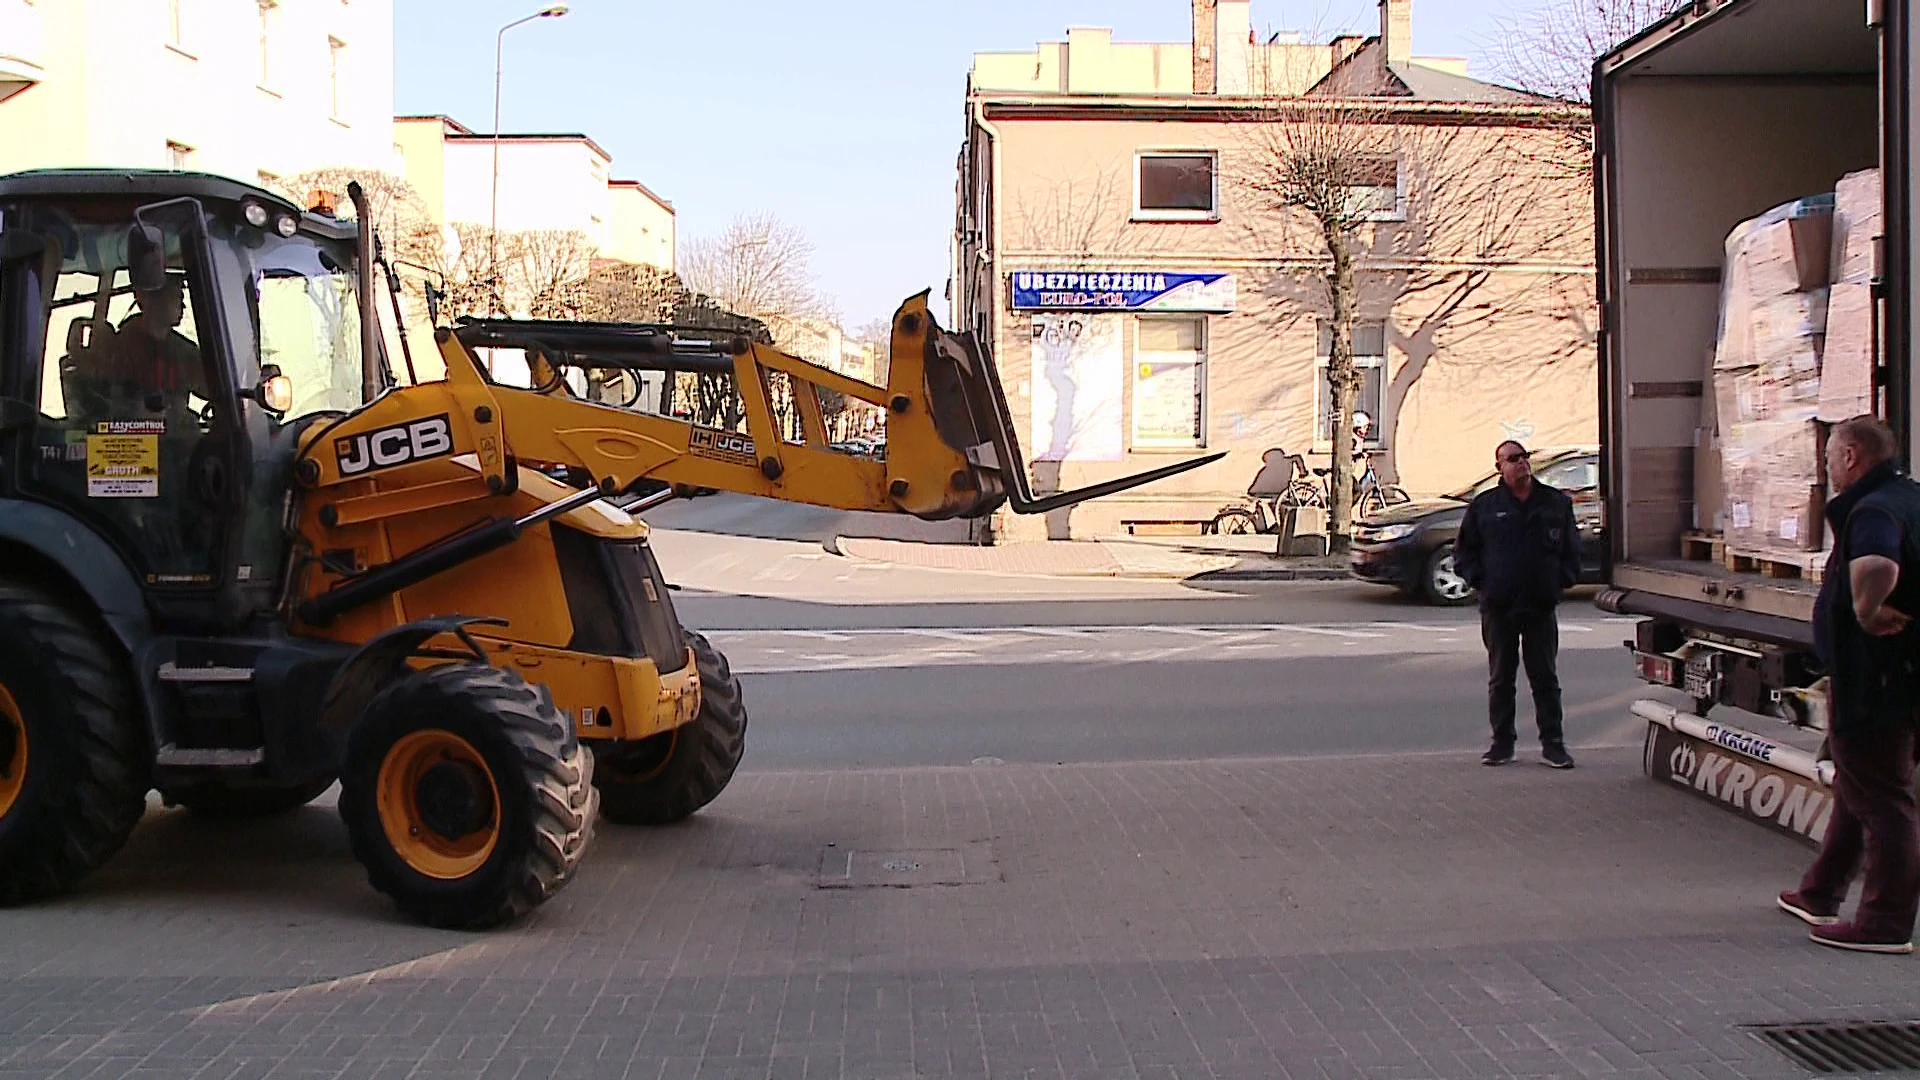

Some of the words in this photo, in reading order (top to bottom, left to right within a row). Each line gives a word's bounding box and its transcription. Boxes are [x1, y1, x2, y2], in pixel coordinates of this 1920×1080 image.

[1018, 273, 1166, 291] UBEZPIECZENIA
[1040, 291, 1128, 306] EURO-POL
[340, 418, 451, 474] JCB
[717, 434, 756, 454] JCB
[1719, 730, 1776, 760] KRONE
